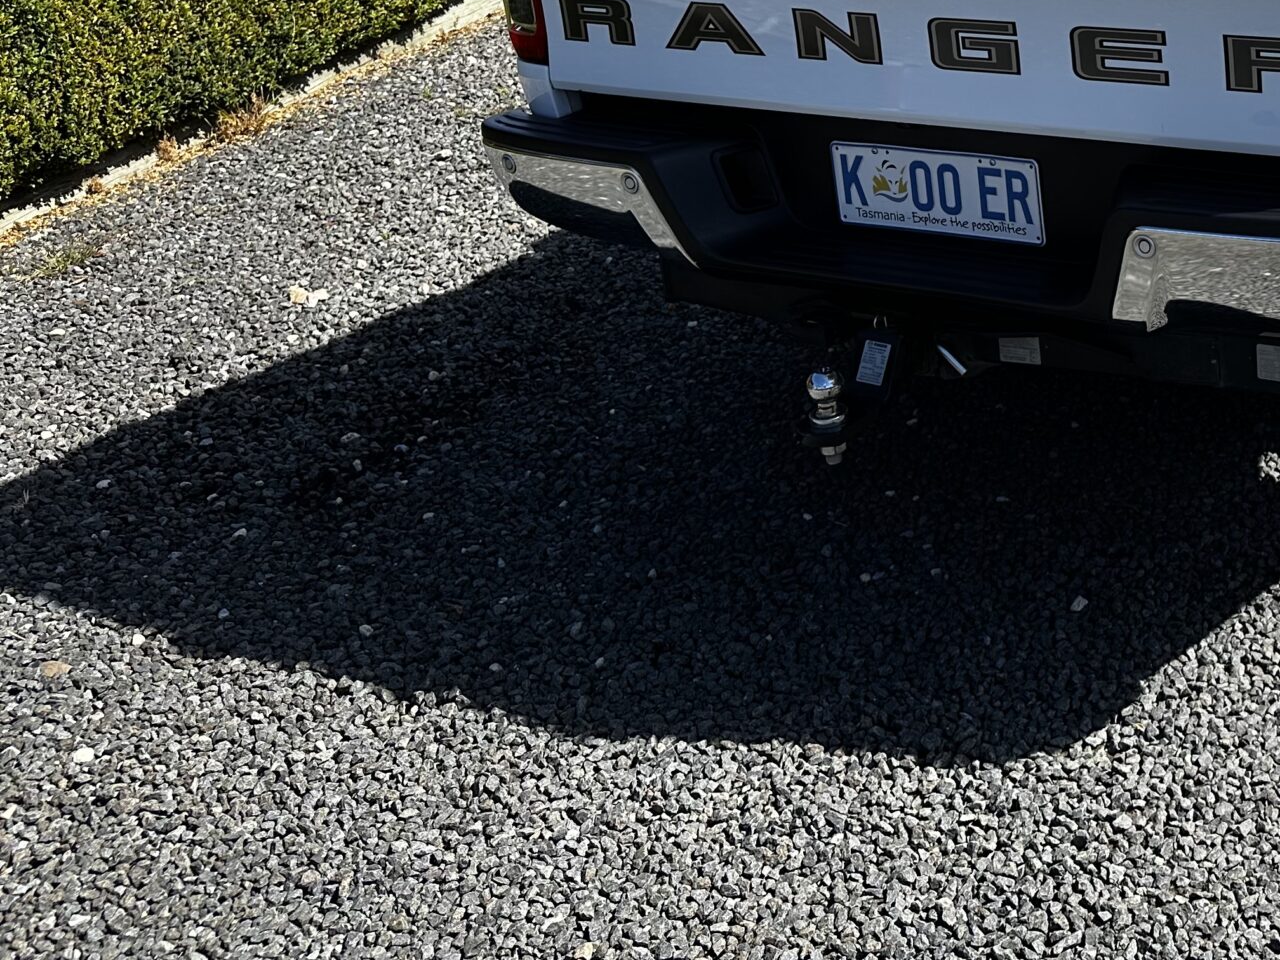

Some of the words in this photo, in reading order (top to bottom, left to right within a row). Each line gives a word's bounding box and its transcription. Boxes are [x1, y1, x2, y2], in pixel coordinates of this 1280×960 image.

[839, 153, 869, 207] K
[976, 166, 1034, 225] ER
[855, 207, 906, 222] Tasmania
[911, 212, 948, 227] Explore
[949, 217, 969, 229] the
[971, 221, 1028, 236] possibilities
